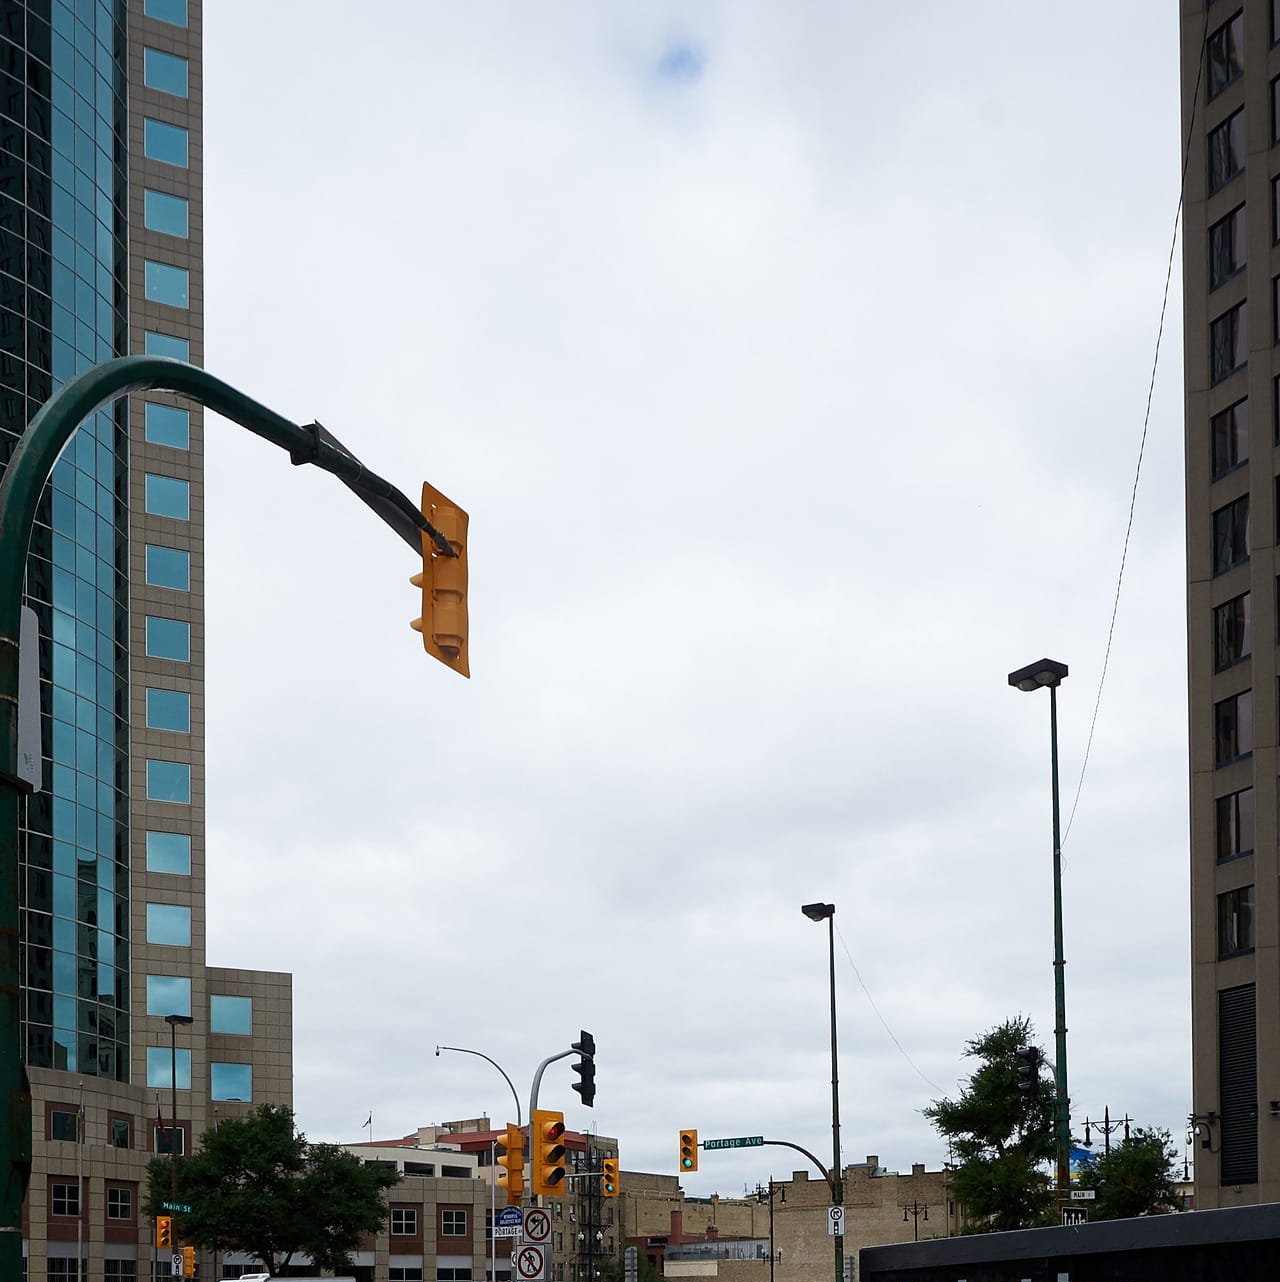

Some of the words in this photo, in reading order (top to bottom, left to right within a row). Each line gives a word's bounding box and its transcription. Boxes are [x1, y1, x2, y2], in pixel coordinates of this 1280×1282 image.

[705, 1139, 741, 1149] Portage
[745, 1137, 762, 1145] Ave
[162, 1201, 181, 1211] Main
[183, 1205, 192, 1213] St
[495, 1227, 518, 1236] PORTAGE
